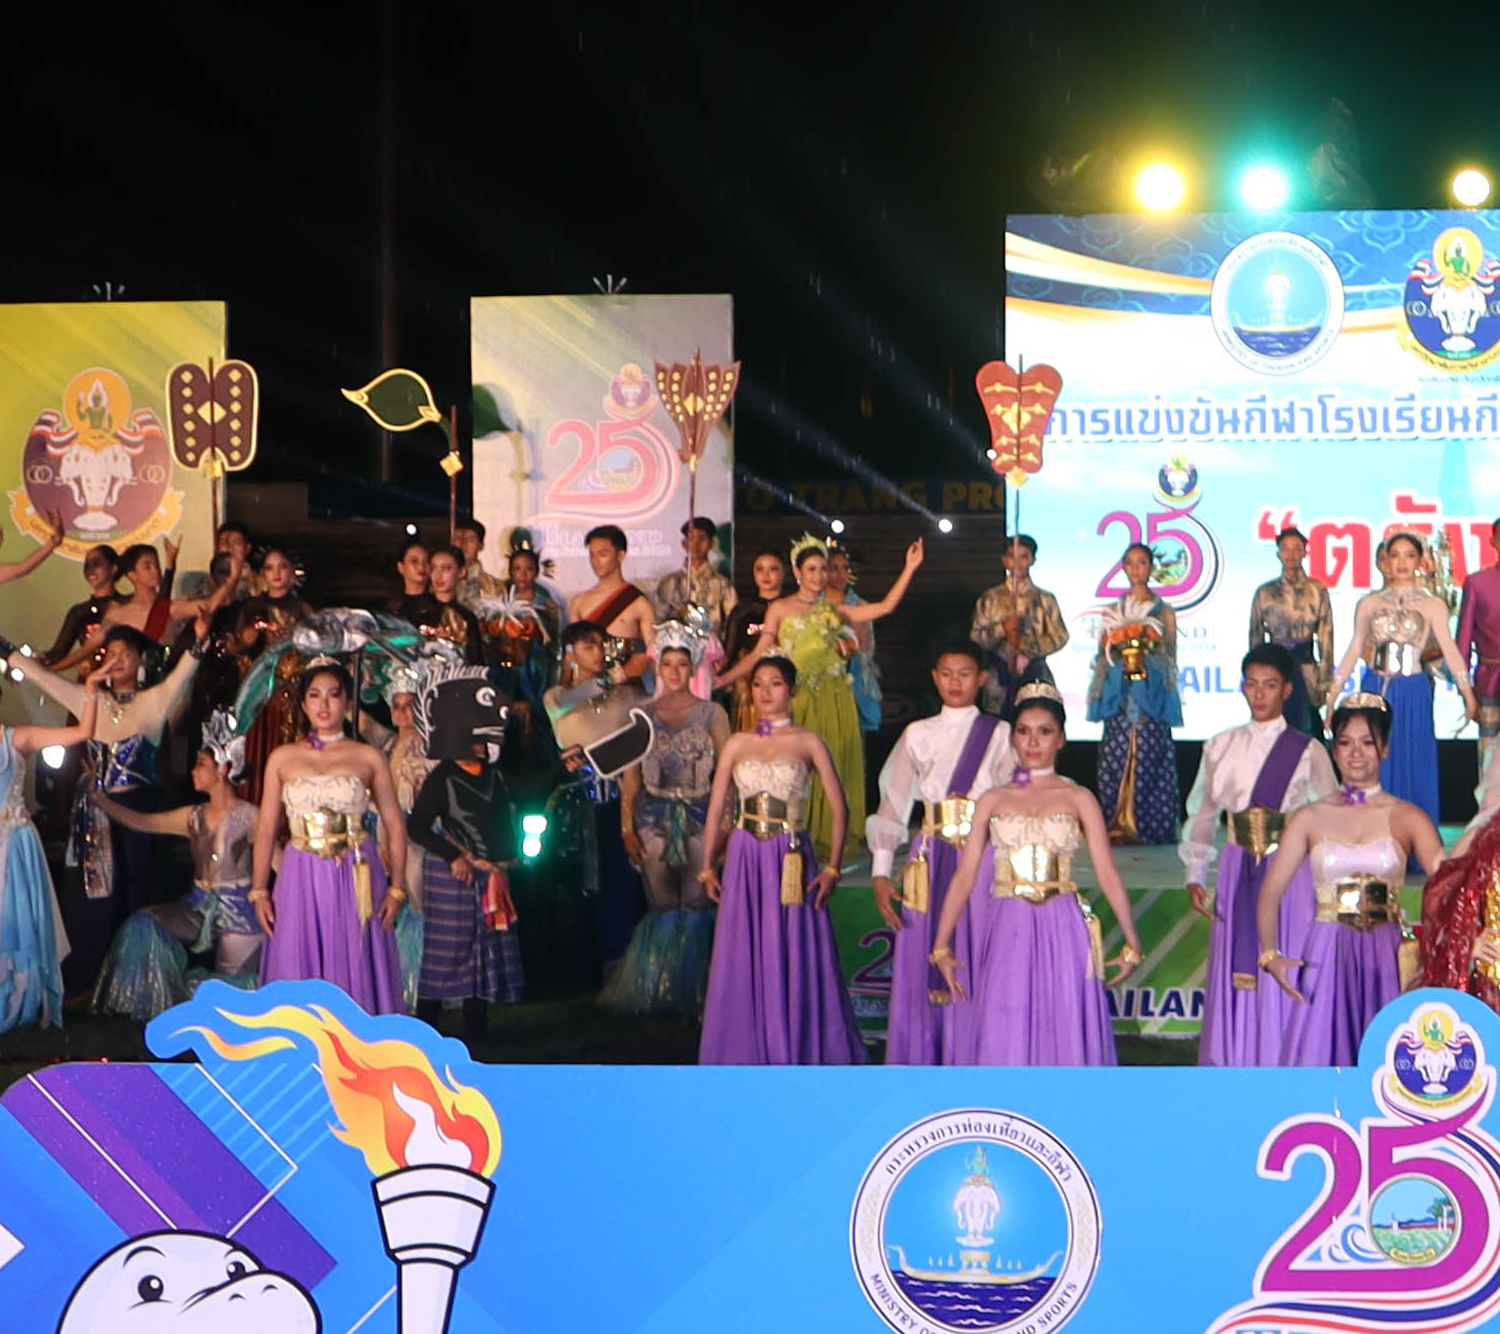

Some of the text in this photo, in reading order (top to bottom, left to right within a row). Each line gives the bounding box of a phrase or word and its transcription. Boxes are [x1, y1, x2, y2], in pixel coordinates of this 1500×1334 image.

[546, 419, 656, 506] 25
[1095, 506, 1204, 599] 25
[884, 1116, 1074, 1183] กระทรวงการท่องเที่ยวและกีฬา
[1257, 1116, 1490, 1293] 25
[870, 1273, 918, 1330] MINISTRY
[1038, 1280, 1078, 1328] SPORTS
